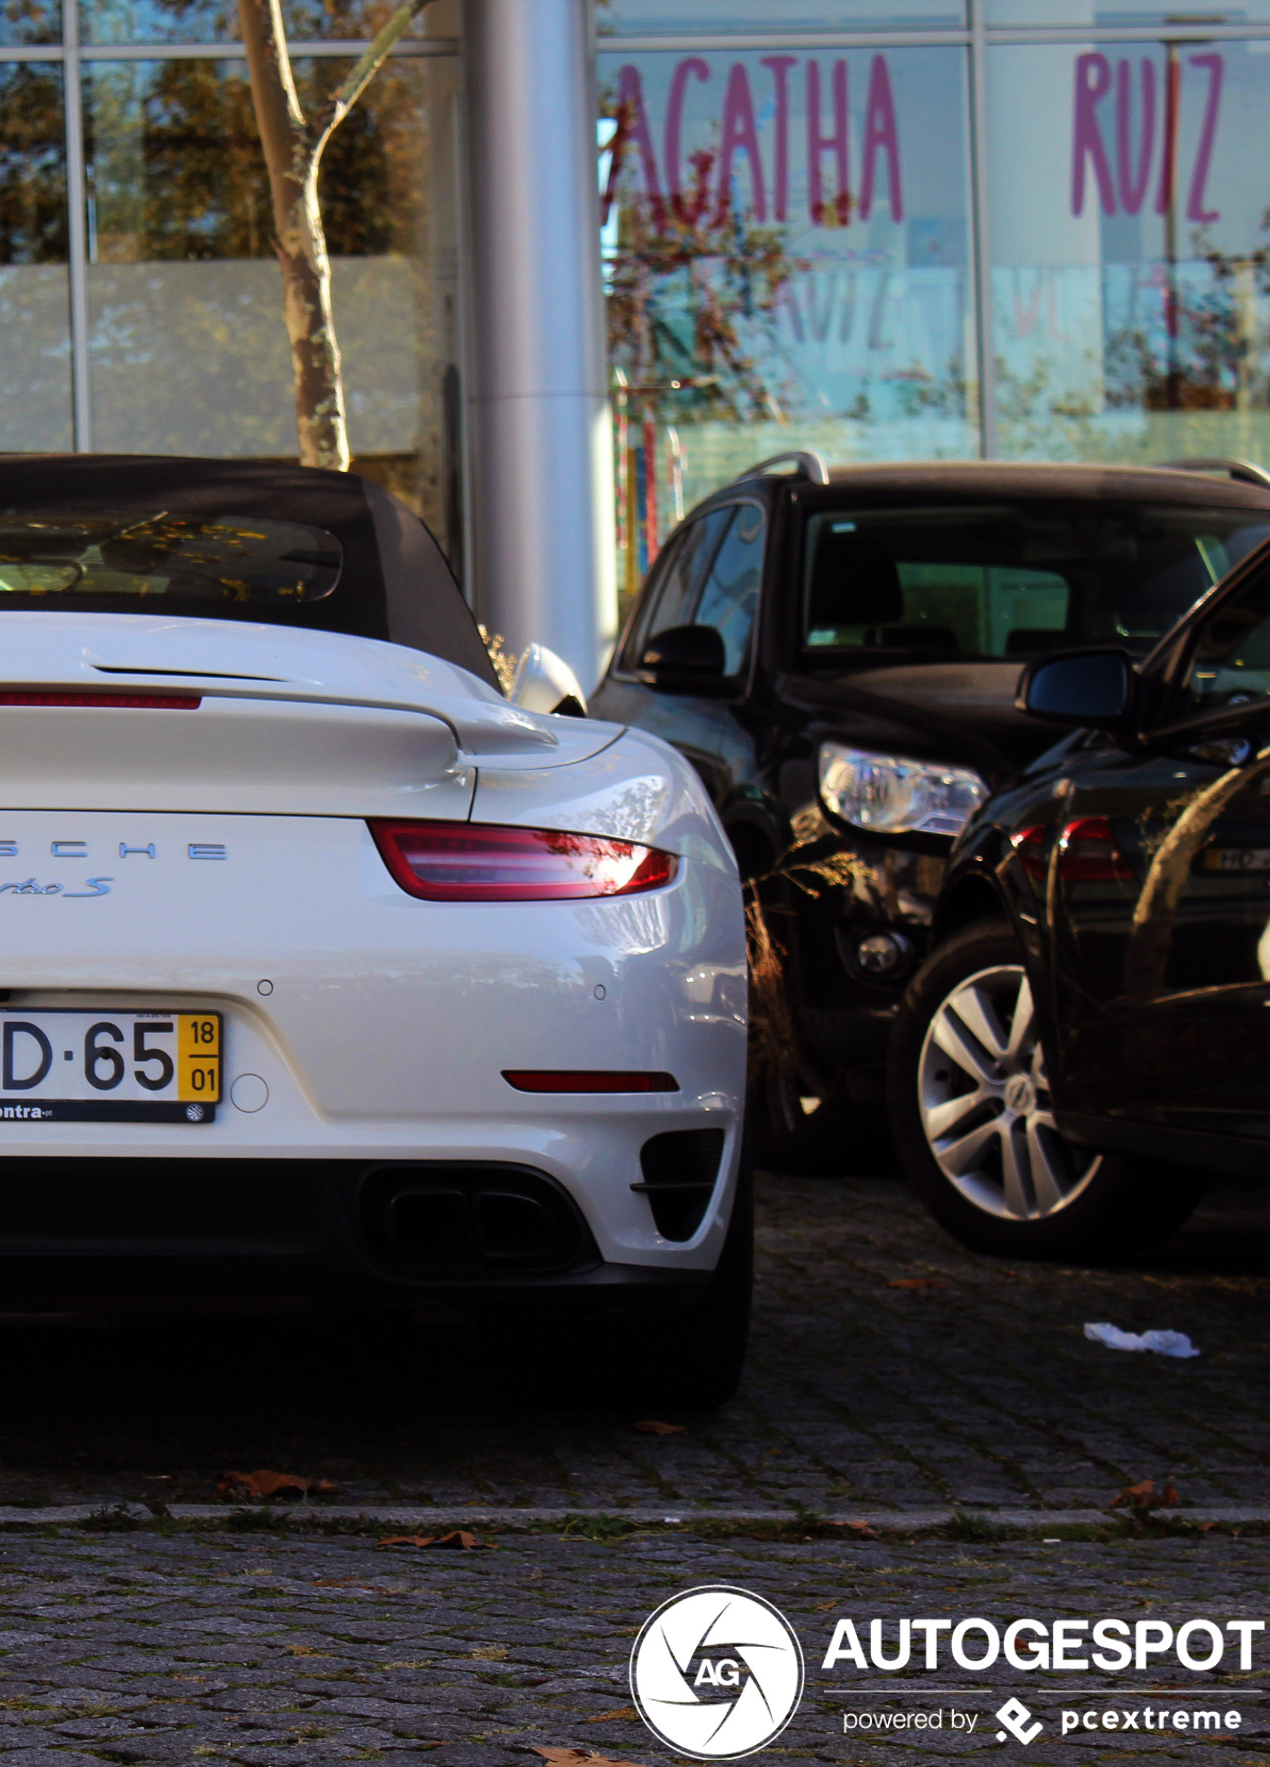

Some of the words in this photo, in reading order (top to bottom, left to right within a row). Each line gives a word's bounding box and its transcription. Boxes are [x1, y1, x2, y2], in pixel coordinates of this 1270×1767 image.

[599, 54, 905, 235] AGATHA
[1071, 53, 1226, 222] RUIZ
[62, 877, 115, 898] S
[190, 1021, 215, 1044] 18
[191, 1068, 215, 1092] 01
